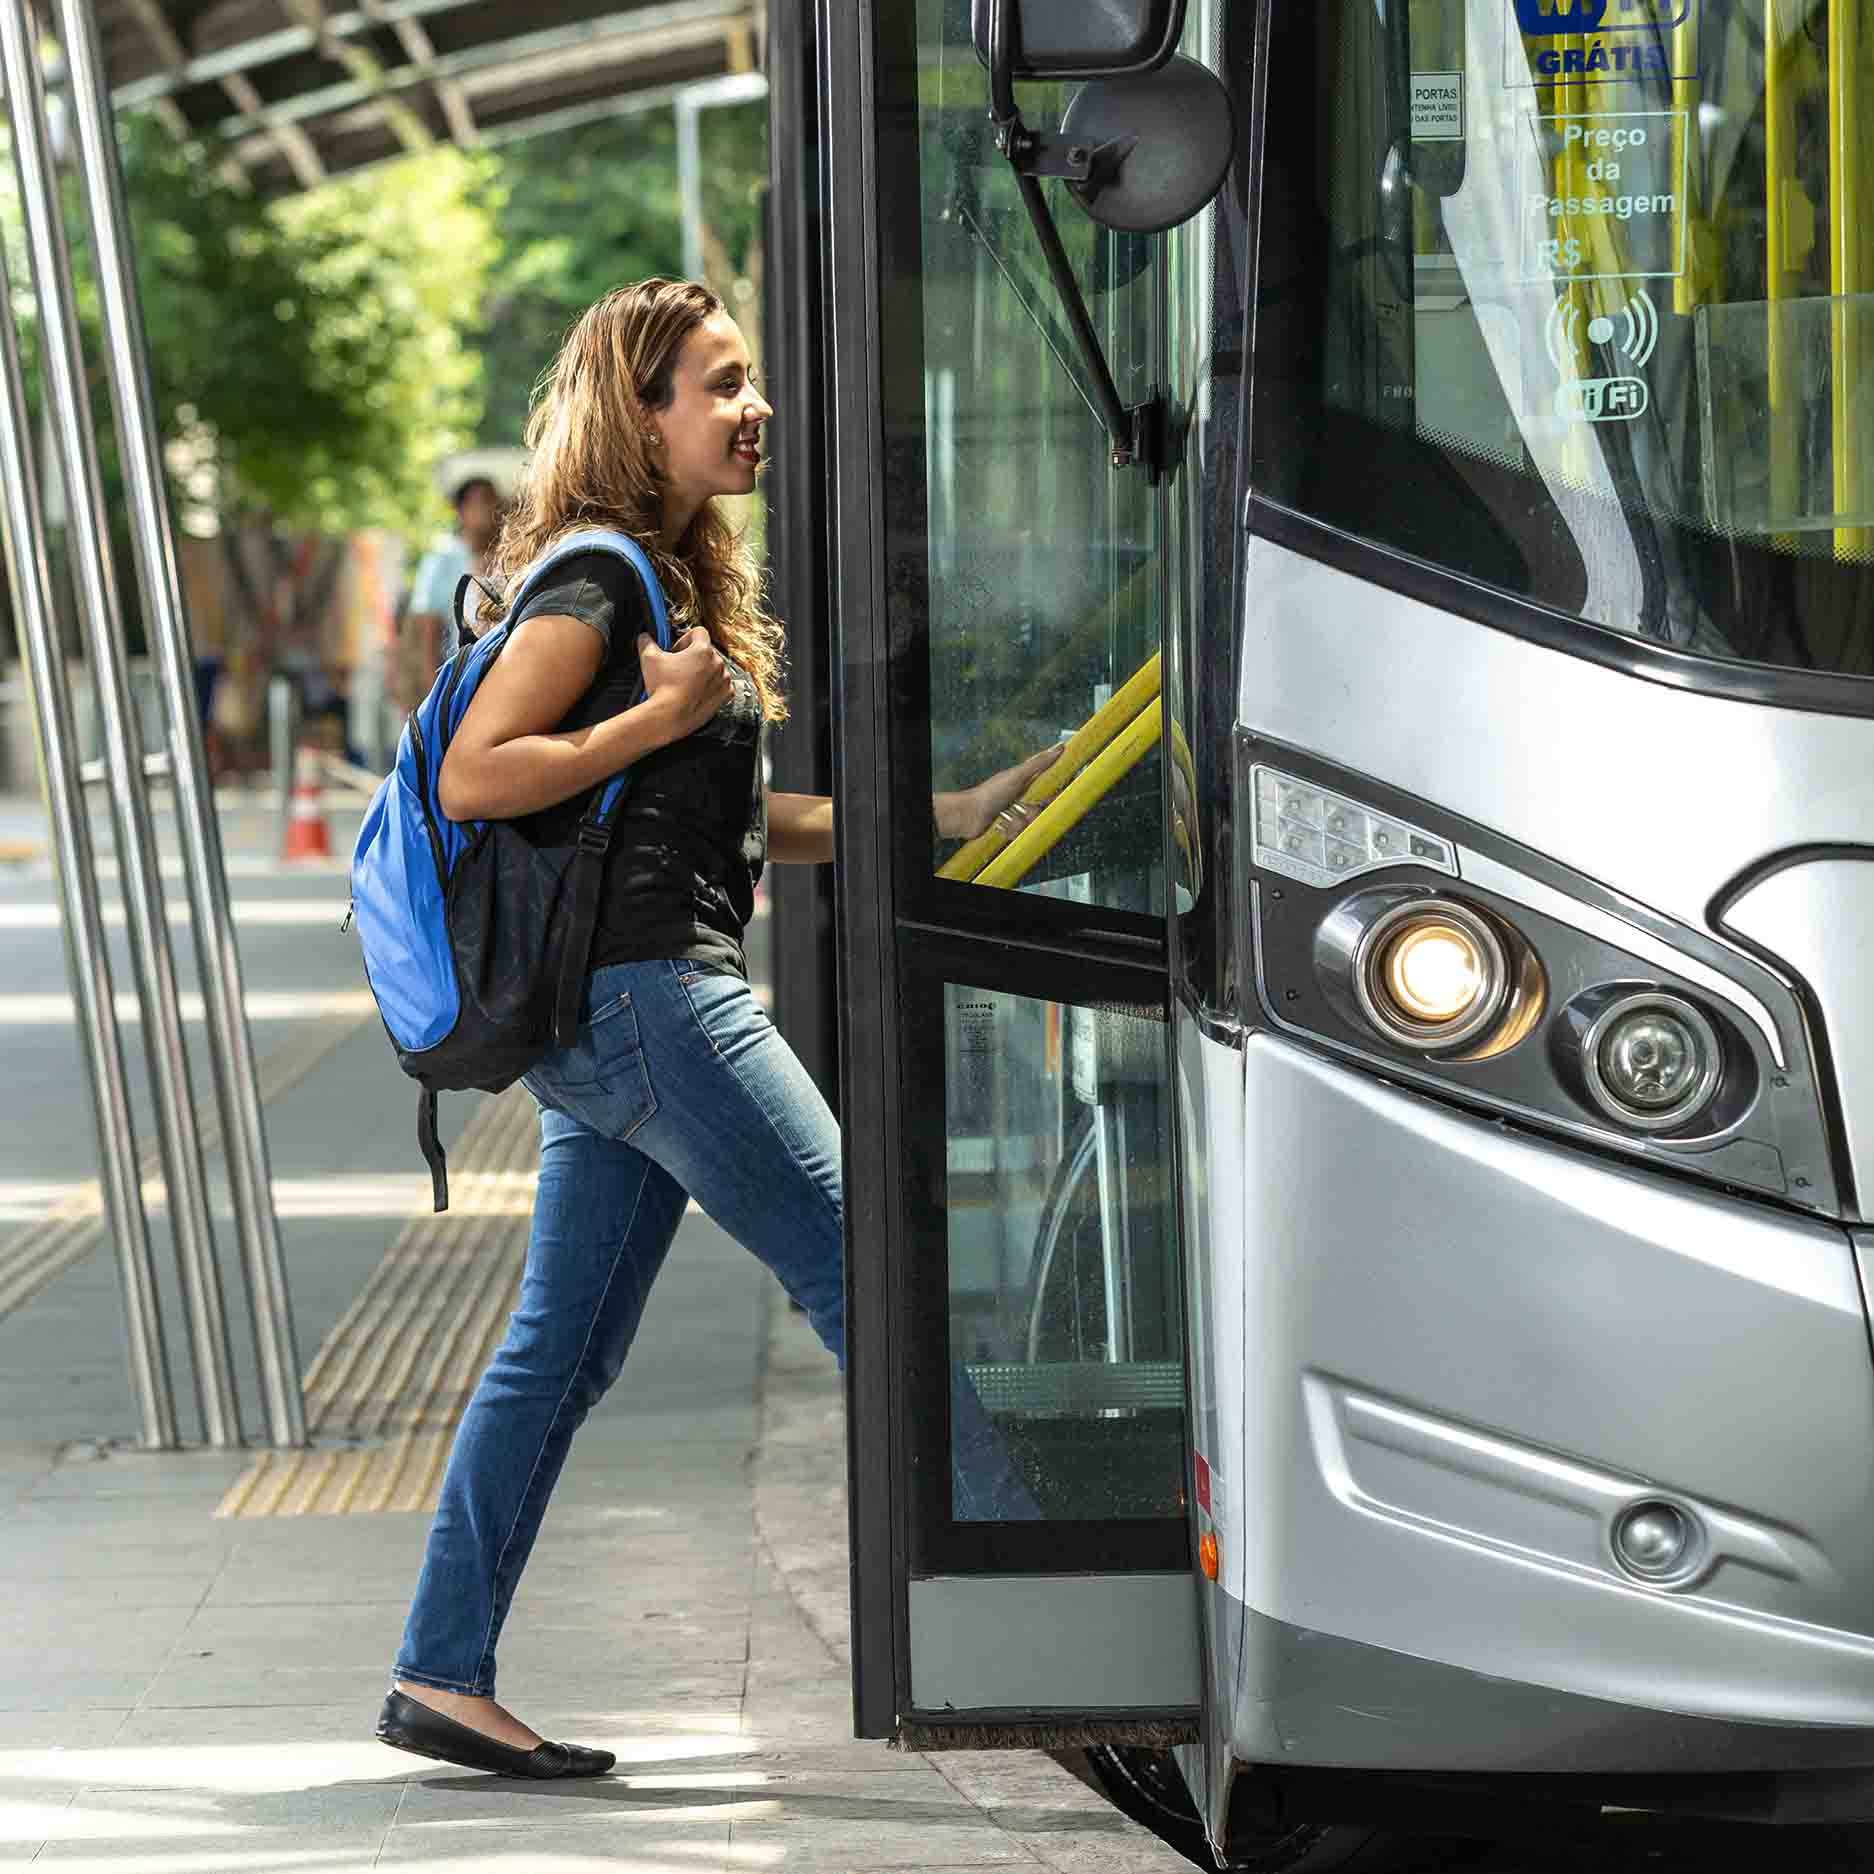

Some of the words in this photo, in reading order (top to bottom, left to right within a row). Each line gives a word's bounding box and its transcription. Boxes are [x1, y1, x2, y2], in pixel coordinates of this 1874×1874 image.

[1536, 40, 1665, 74] GRÁTIS
[1415, 88, 1457, 100] PORTAS
[1564, 125, 1647, 152] Preço
[1586, 158, 1621, 181] da
[1529, 193, 1676, 219] Passagem
[1537, 239, 1582, 271] R$
